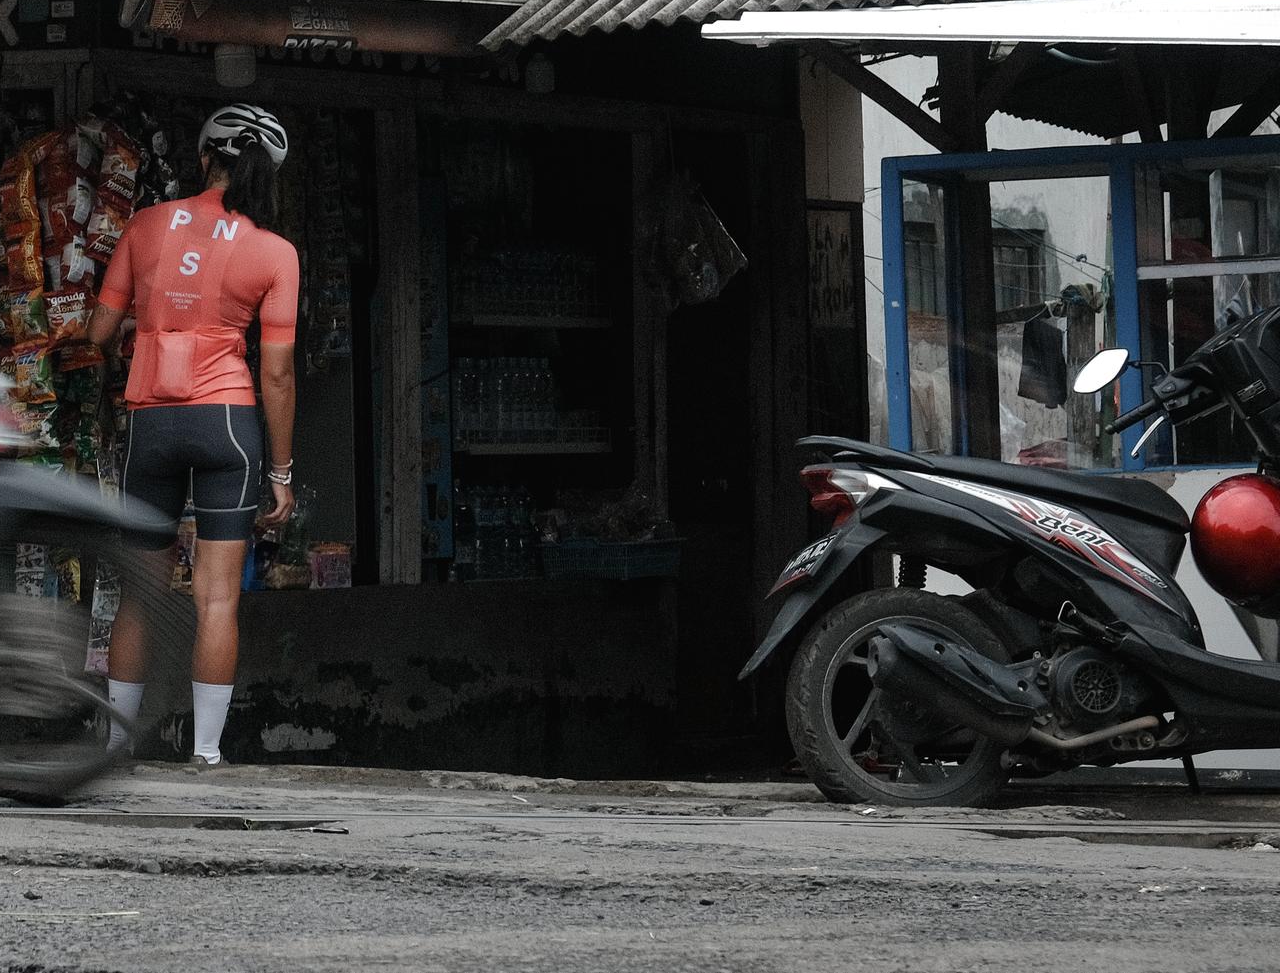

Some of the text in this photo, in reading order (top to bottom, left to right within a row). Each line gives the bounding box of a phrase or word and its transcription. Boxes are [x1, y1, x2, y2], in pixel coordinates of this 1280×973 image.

[170, 208, 239, 241] P N
[179, 251, 201, 276] S
